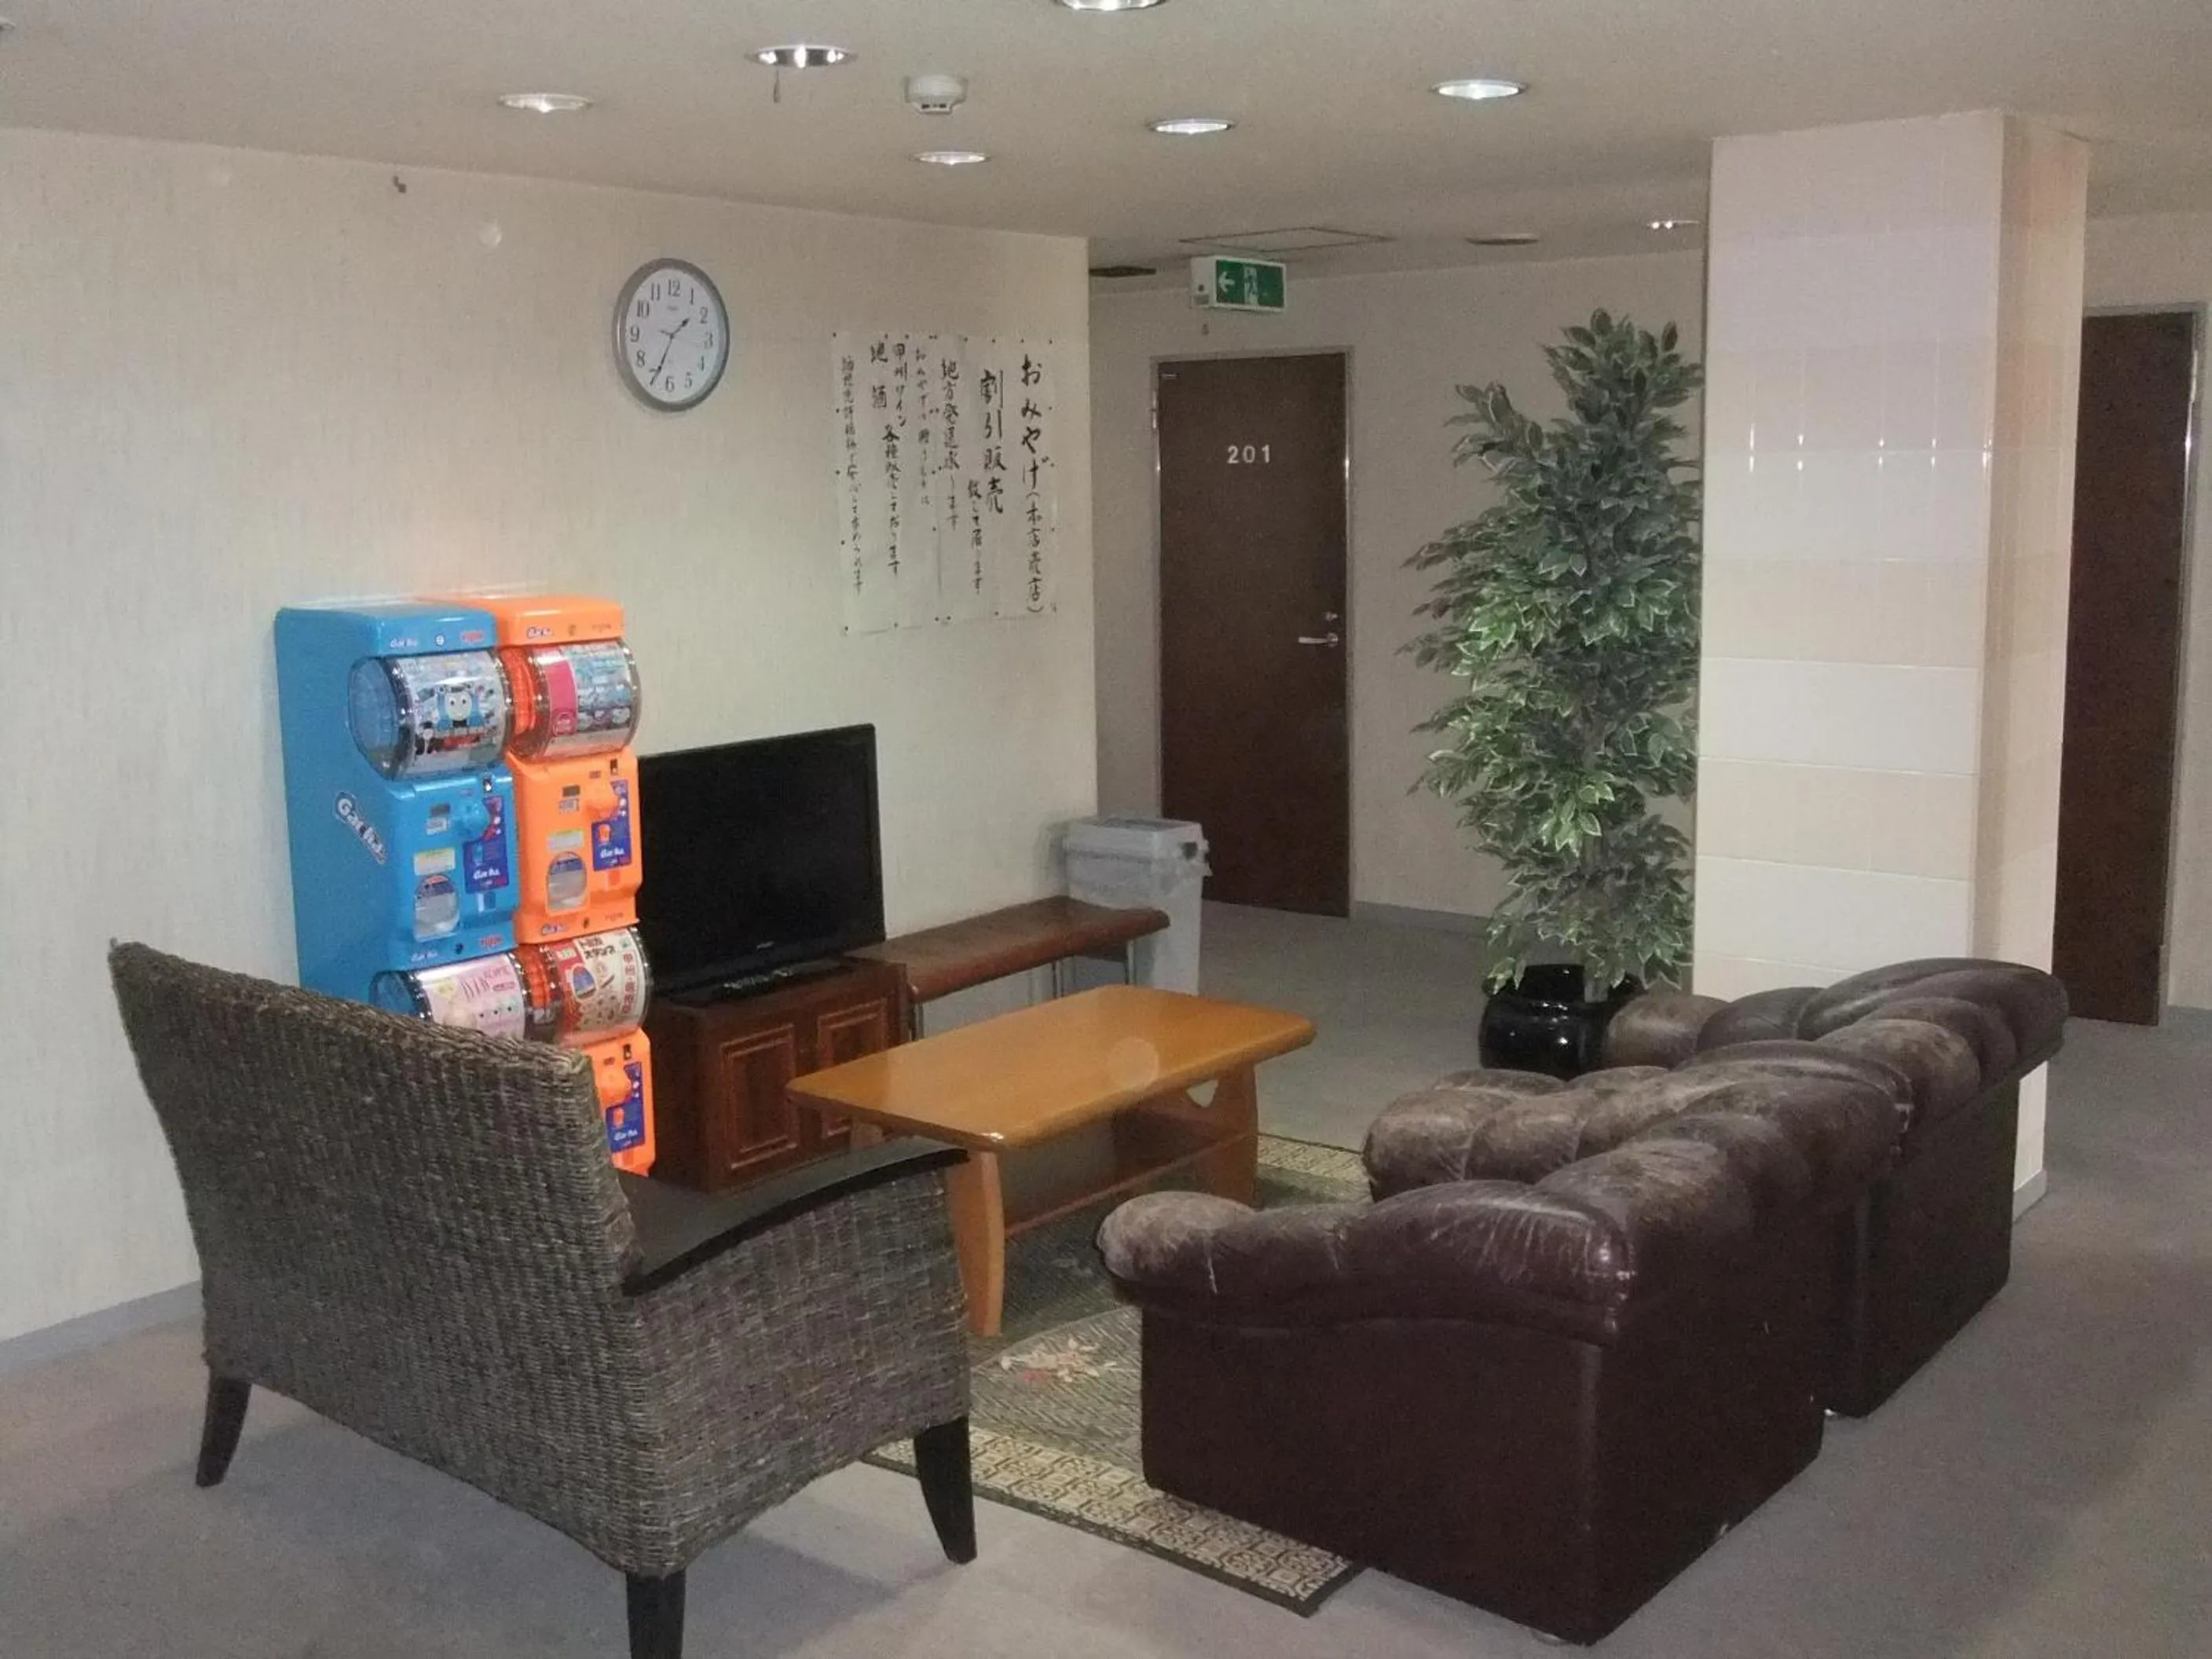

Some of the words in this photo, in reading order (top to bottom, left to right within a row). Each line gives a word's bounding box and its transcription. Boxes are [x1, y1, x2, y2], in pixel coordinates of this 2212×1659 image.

[650, 283, 661, 301] 11
[668, 280, 680, 296] 12
[637, 300, 650, 318] 10
[700, 307, 709, 324] 2
[631, 325, 640, 342] 9
[705, 332, 713, 349] 3
[636, 350, 646, 368] 8
[698, 355, 705, 372] 4
[665, 376, 675, 393] 6
[685, 372, 693, 389] 5
[1227, 445, 1271, 464] 201
